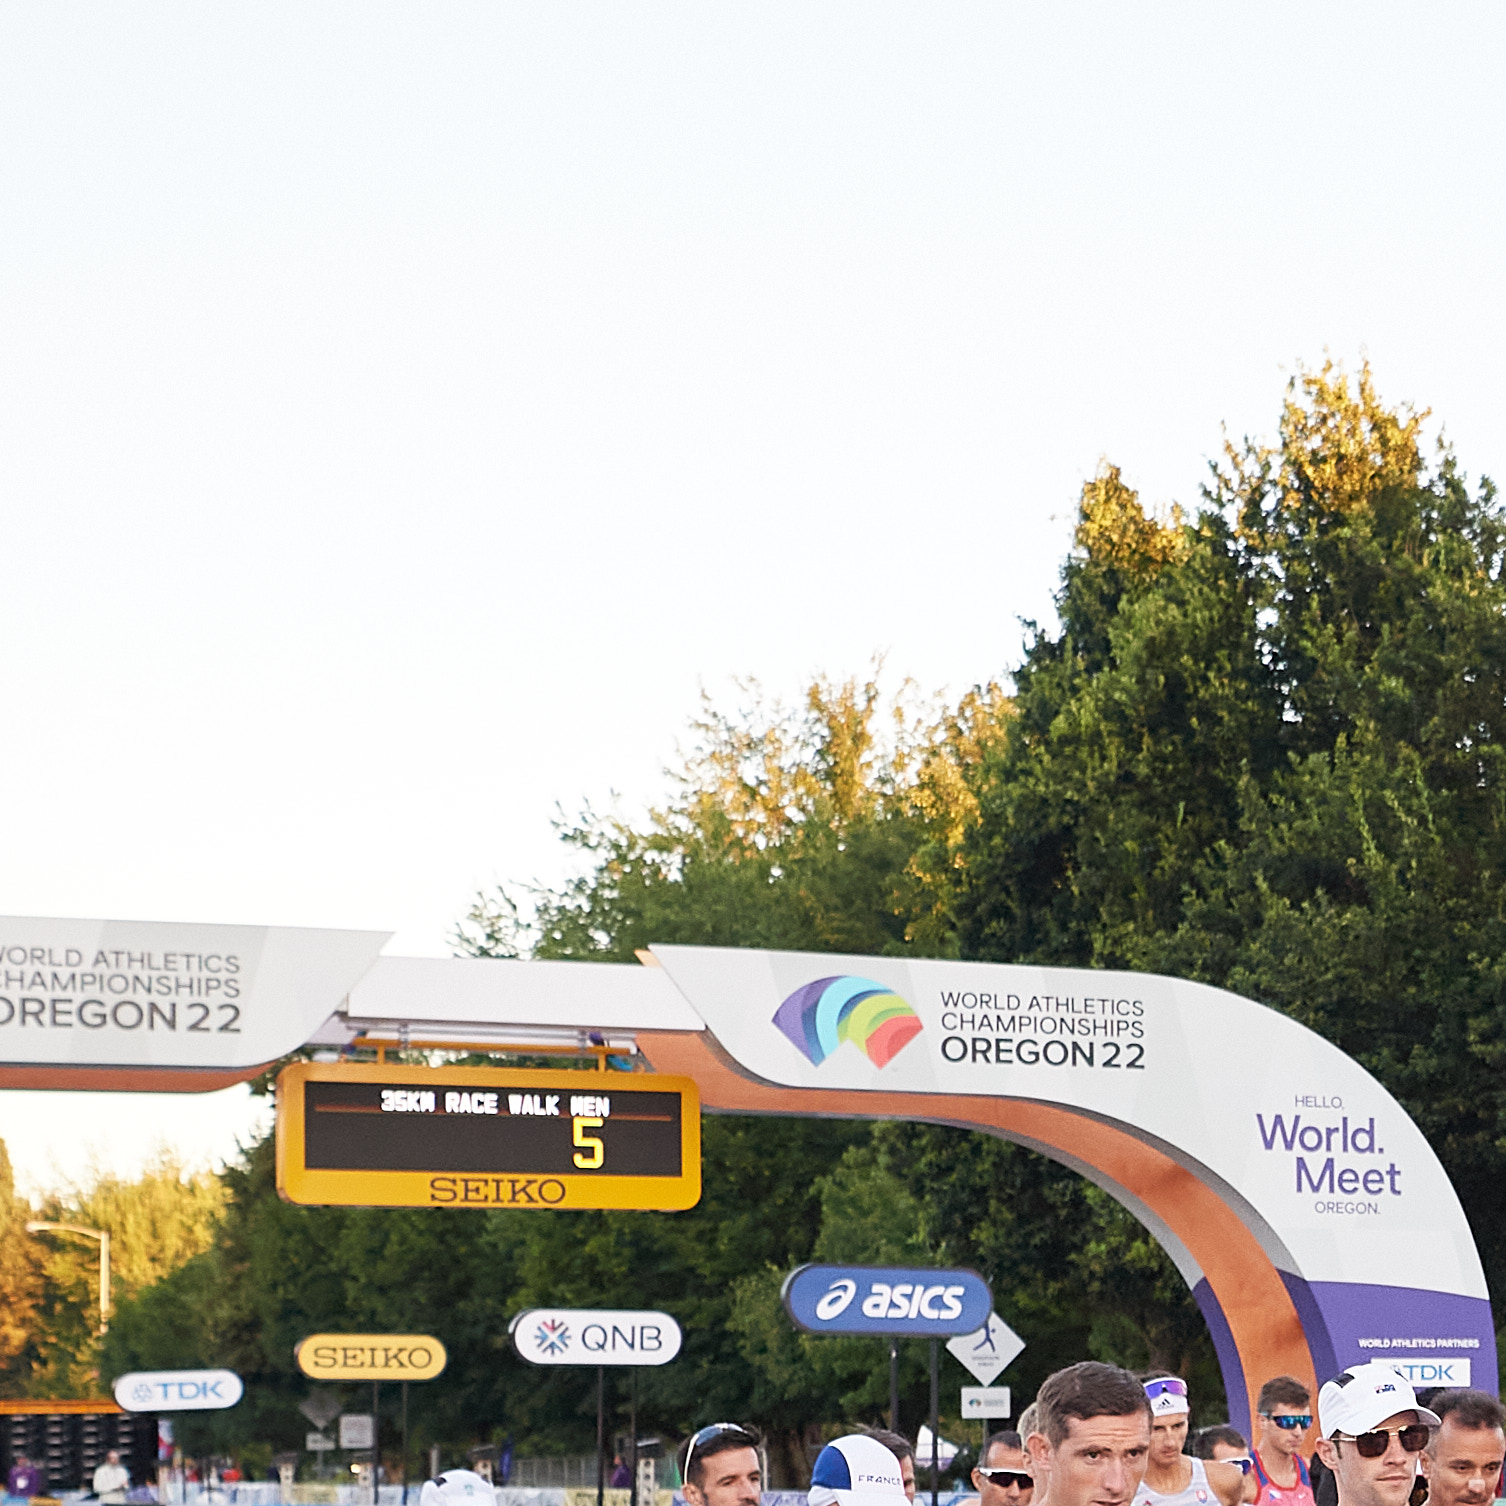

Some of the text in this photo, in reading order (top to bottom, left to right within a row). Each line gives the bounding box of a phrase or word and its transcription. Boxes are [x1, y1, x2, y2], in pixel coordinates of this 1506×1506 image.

[92, 949, 241, 974] ATHLETICS
[0, 970, 241, 998] HAMPIONSHIPS
[940, 991, 1145, 1017] WORLD ATHLETICS
[941, 1013, 1145, 1039] CHAMPIONSHIPS
[381, 1090, 610, 1118] 35KM RACE WALK MEN
[1294, 1094, 1345, 1111] HELLO,
[573, 1117, 605, 1169] 5
[1256, 1113, 1385, 1155] World.
[1295, 1156, 1402, 1196] Meet
[430, 1177, 566, 1204] SEIKO
[1314, 1201, 1381, 1215] OREGON.
[862, 1283, 965, 1320] asics
[581, 1324, 663, 1351] QNB
[1358, 1338, 1480, 1348] WORLD ATHLETICS PARTNERS
[313, 1346, 433, 1370] SEIKO
[1403, 1365, 1455, 1381] TDK
[154, 1381, 224, 1400] TDK
